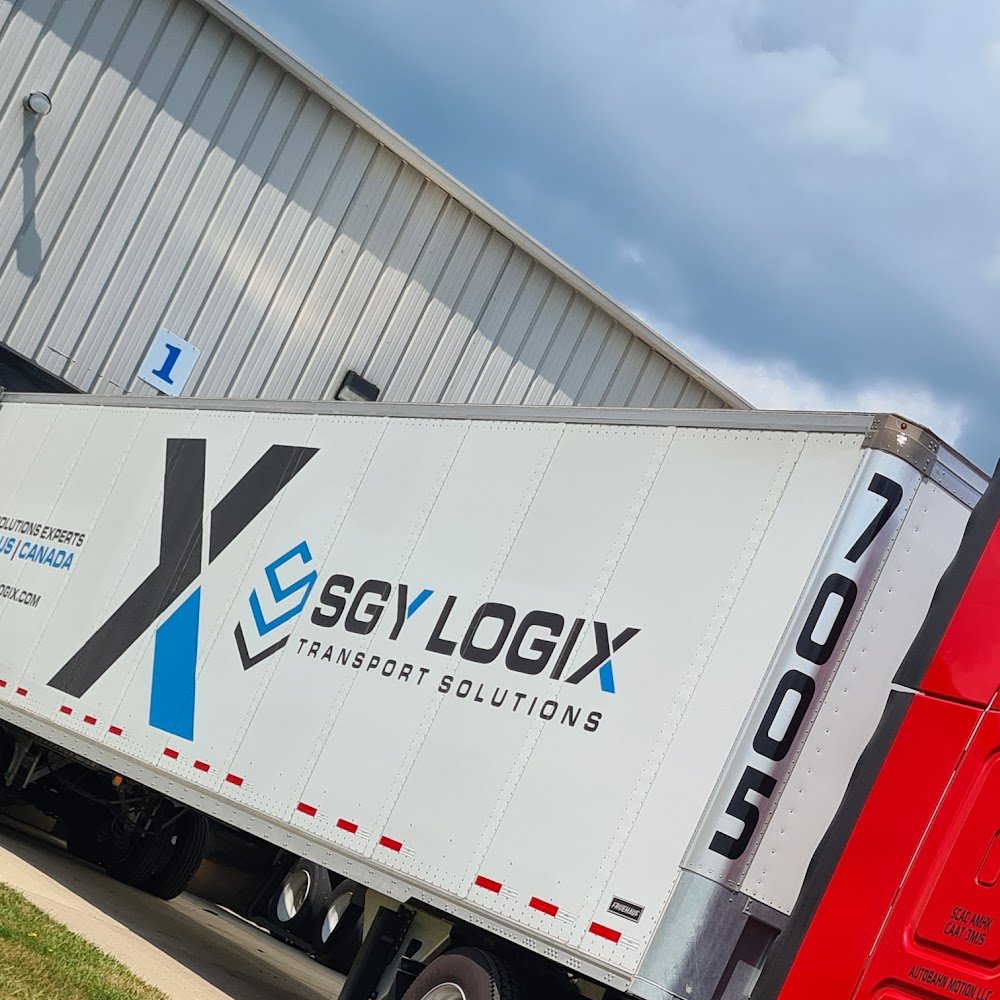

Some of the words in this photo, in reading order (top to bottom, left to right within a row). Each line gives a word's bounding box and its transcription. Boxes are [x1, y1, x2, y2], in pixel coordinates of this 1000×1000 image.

[152, 343, 182, 385] 1
[0, 516, 42, 537] OLUTIONS
[40, 525, 86, 547] EXPERTS
[18, 541, 74, 571] CANADA
[310, 573, 435, 641] SGY
[425, 595, 642, 695] LOGIX
[709, 472, 904, 860] 7005
[296, 638, 430, 686] TRANSPORT
[438, 676, 603, 732] SOLUTIONS
[943, 922, 966, 939] CAAT
[950, 907, 969, 924] SCAC
[969, 912, 994, 931] AMHK
[908, 965, 948, 988] AUTOBAHN
[947, 976, 978, 998] MOTION
